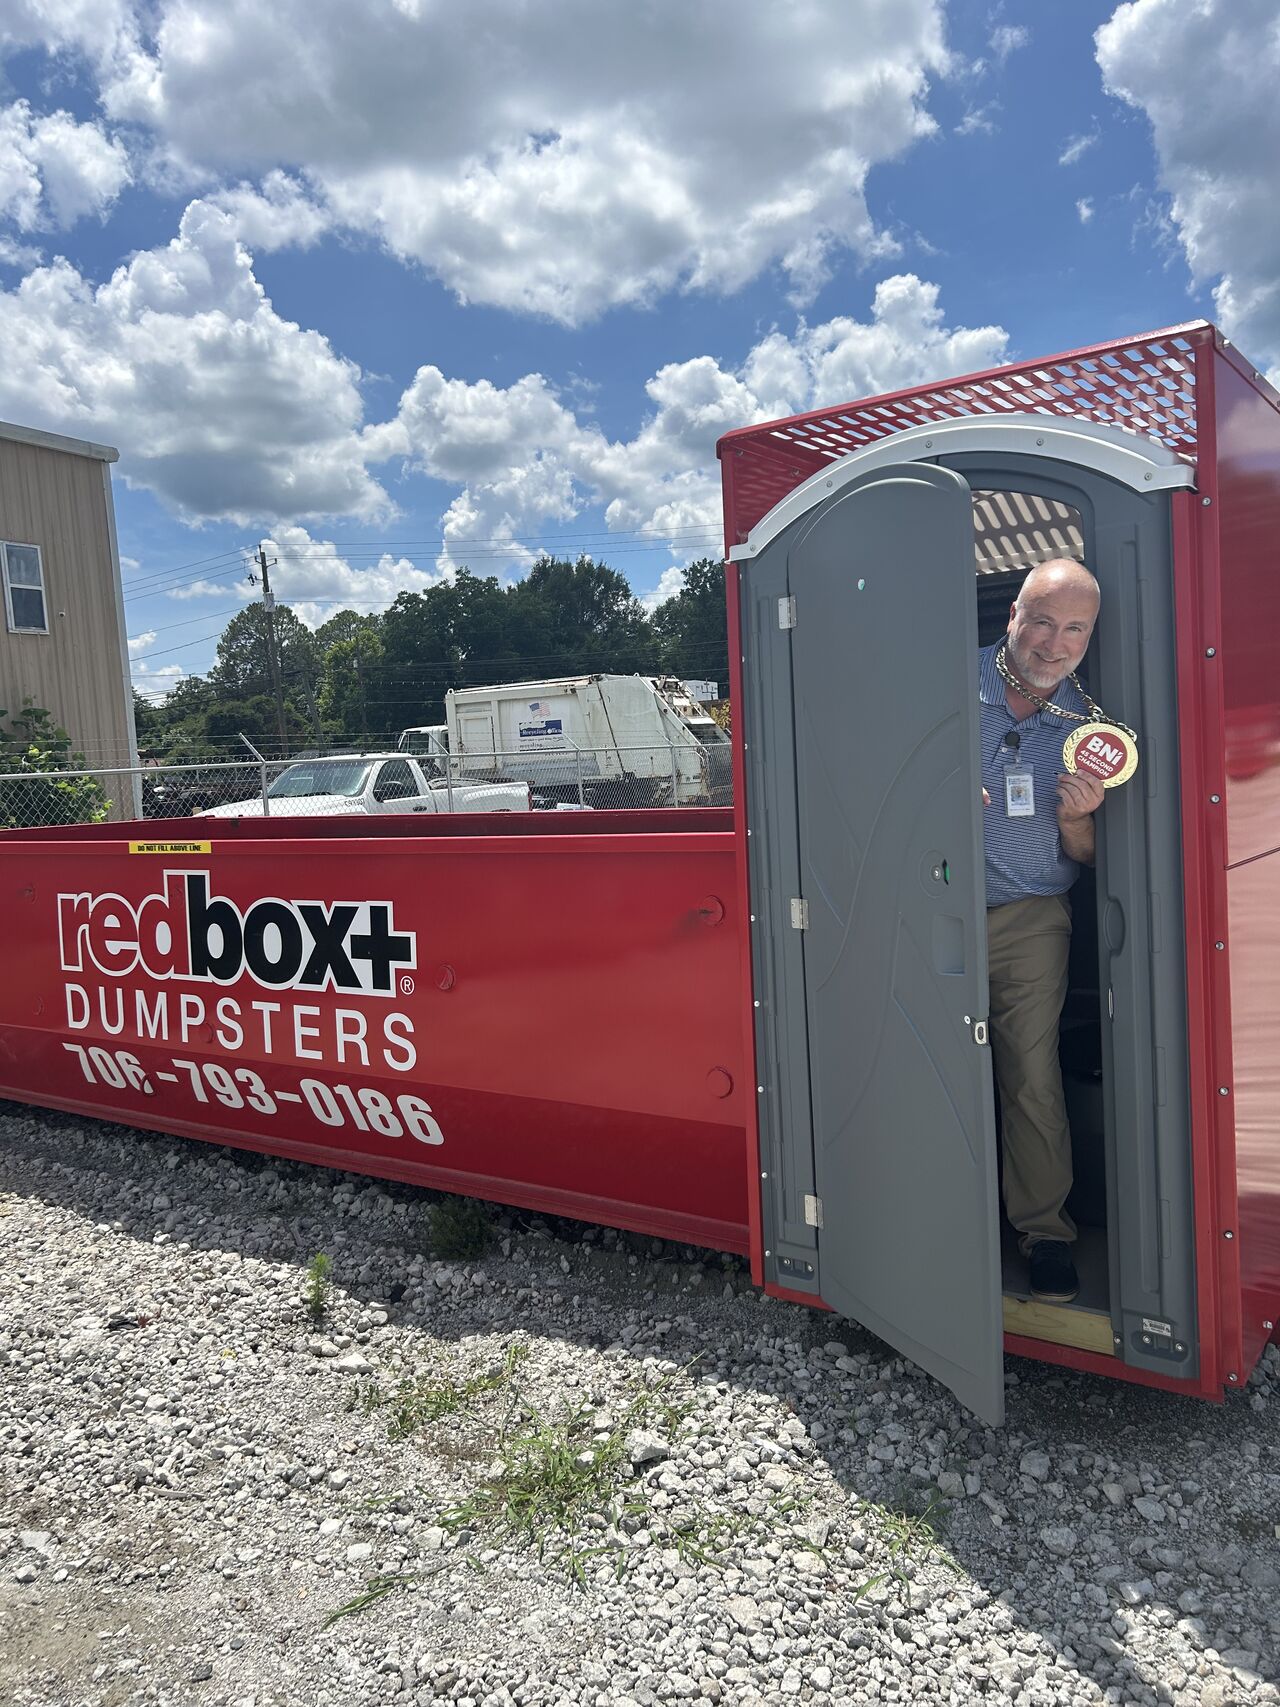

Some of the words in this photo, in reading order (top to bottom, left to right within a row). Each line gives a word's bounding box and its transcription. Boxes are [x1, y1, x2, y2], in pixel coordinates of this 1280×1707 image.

[1077, 755, 1110, 777] CHAMPION
[1088, 754, 1113, 772] SECOND
[65, 982, 417, 1072] DUMPSTERS
[62, 1042, 444, 1146] 706-793-0186
